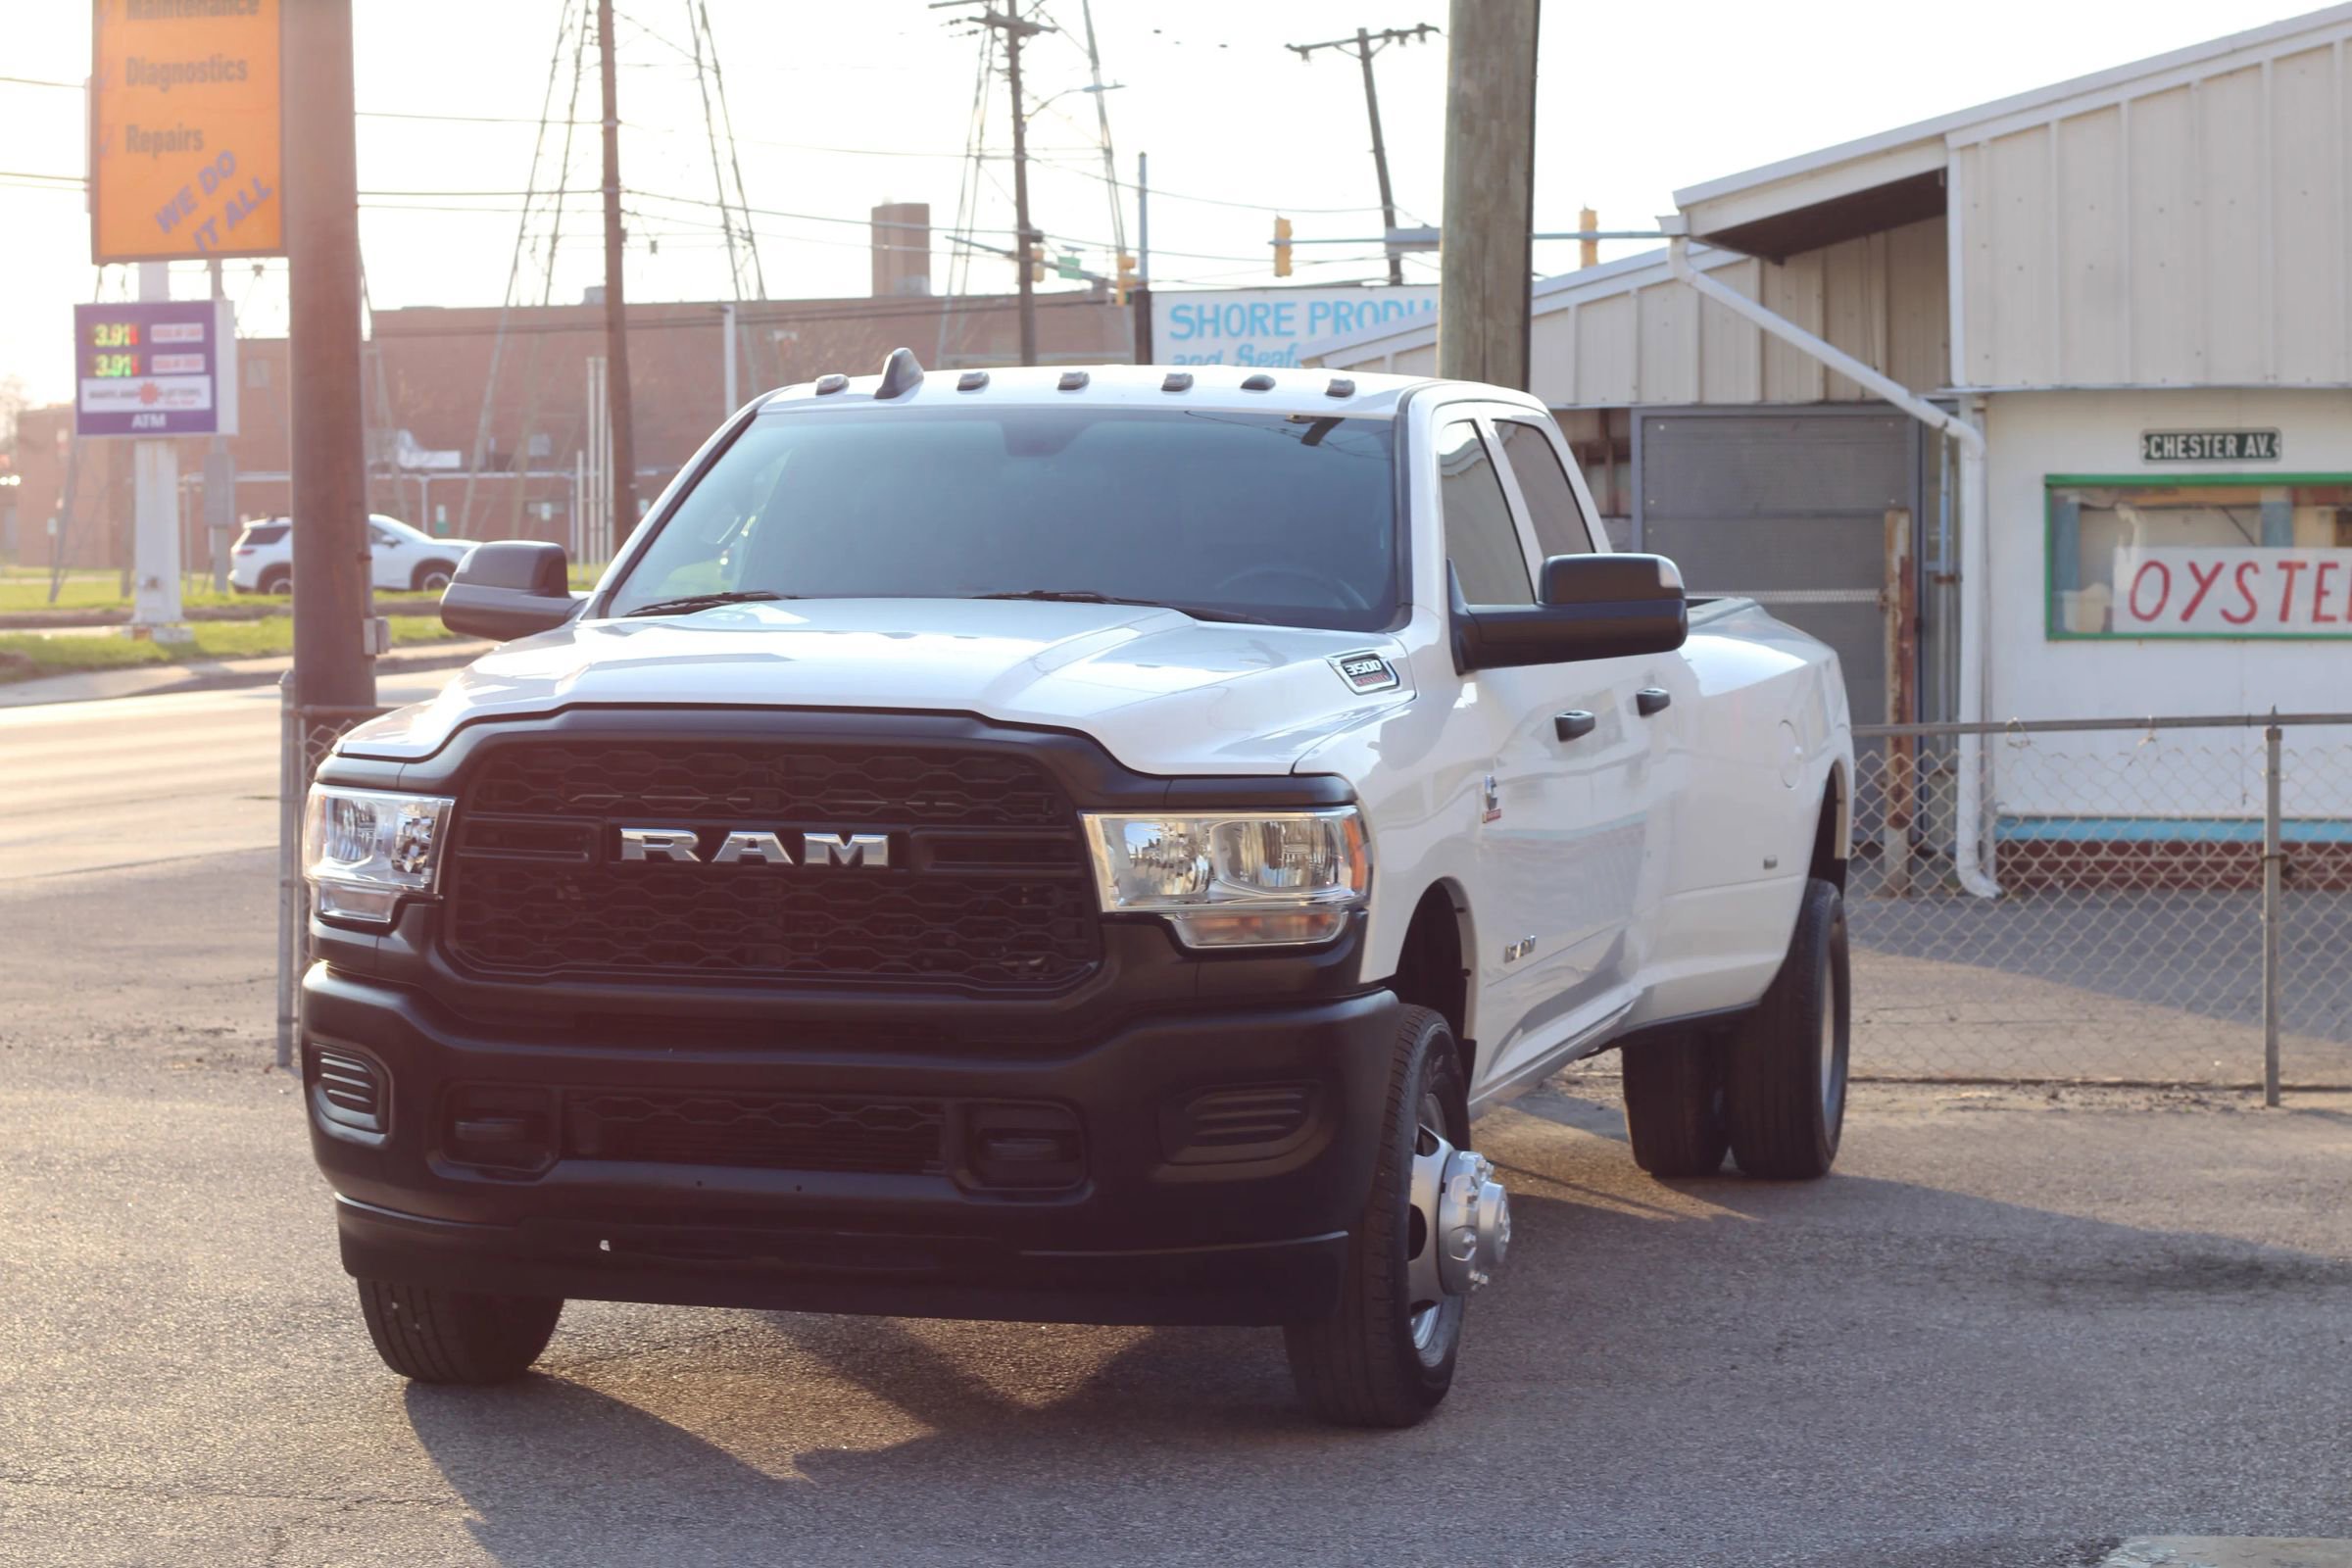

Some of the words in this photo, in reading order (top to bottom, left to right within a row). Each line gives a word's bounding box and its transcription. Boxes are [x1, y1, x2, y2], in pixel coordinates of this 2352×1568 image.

[124, 54, 248, 93] Diagnostics
[124, 122, 204, 158] Repairs
[155, 185, 198, 234] WE
[198, 150, 235, 195] DO
[193, 217, 219, 252] IT
[224, 176, 273, 231] ALL
[1169, 301, 1298, 341] SHORE
[1236, 342, 1301, 368] Seaf
[131, 413, 167, 428] ATM
[2149, 434, 2238, 459] CHESTER
[2244, 432, 2272, 458] AV.
[2129, 560, 2352, 625] OYSTE
[1346, 659, 1383, 676] 3500
[620, 828, 889, 867] RAM
